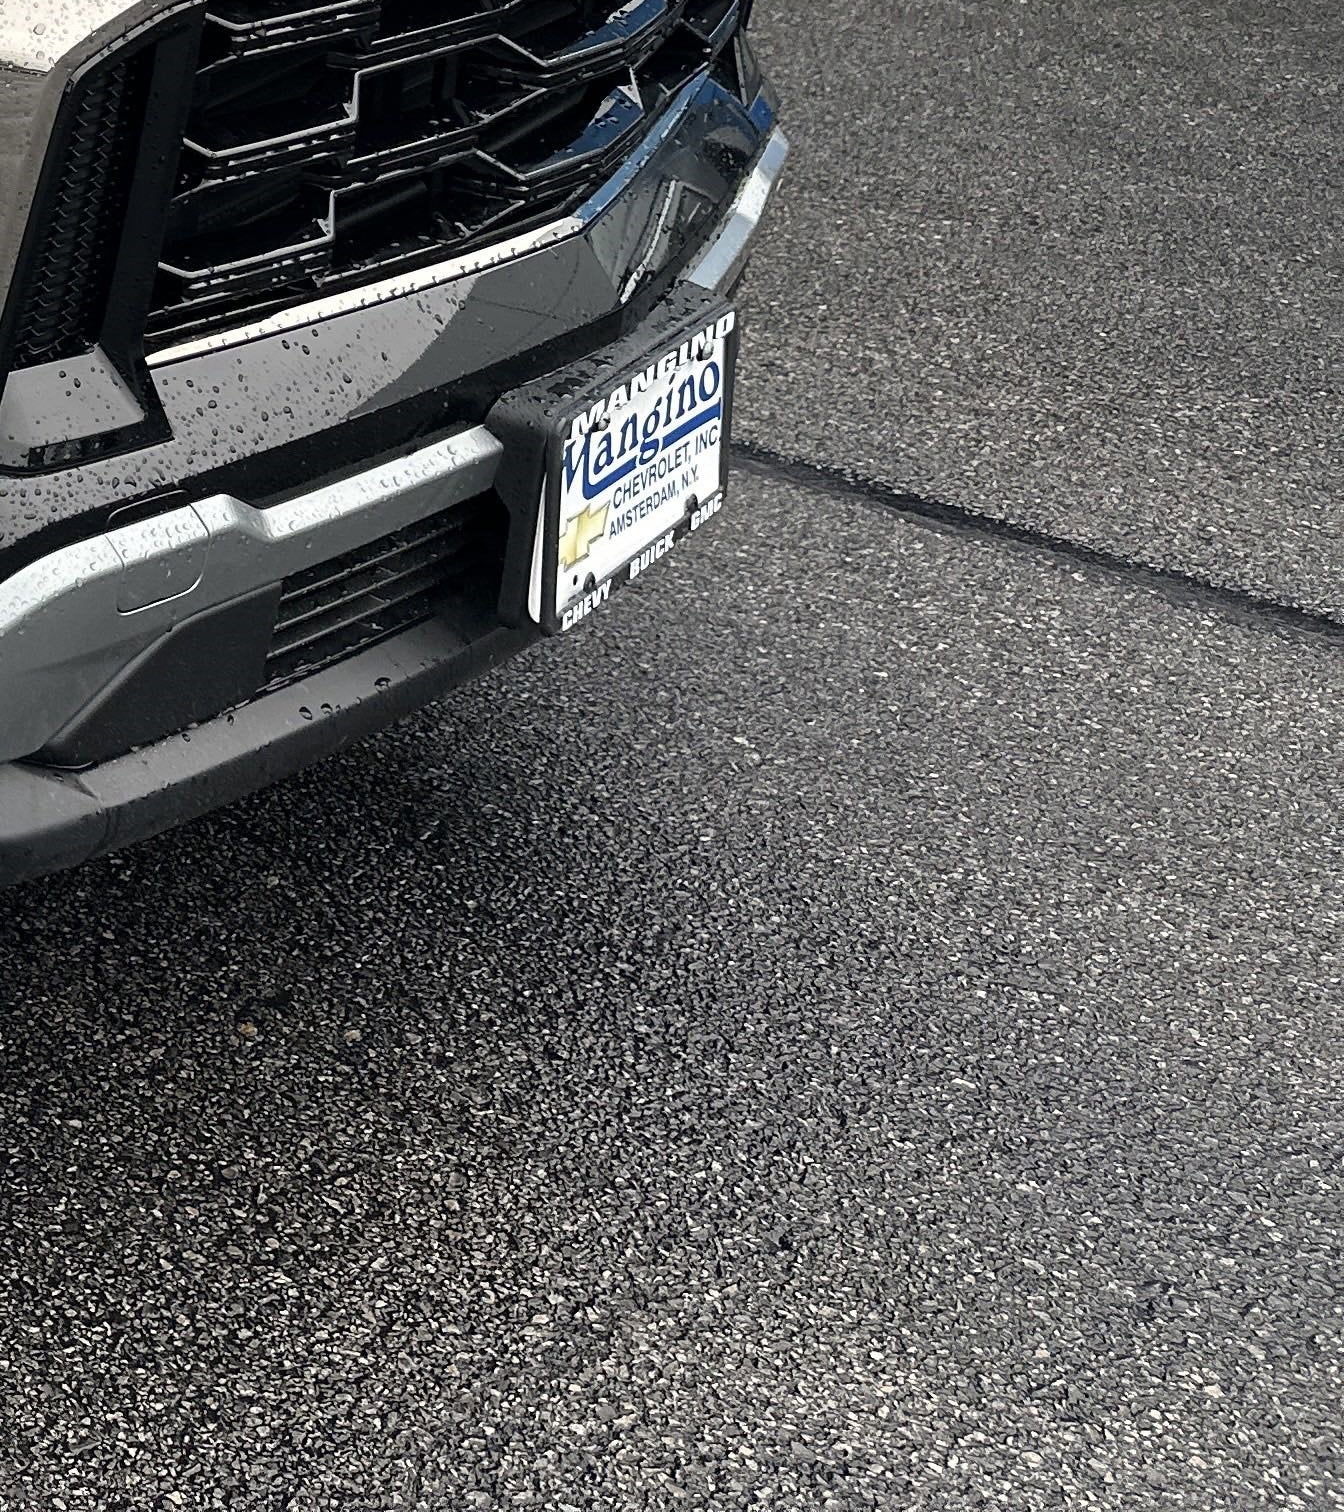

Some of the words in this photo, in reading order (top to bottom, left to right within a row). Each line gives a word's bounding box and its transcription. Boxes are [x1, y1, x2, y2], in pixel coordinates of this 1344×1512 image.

[561, 361, 721, 499] Mangino
[570, 311, 735, 440] MANGINO
[609, 478, 680, 538] AMSTERDAM,
[613, 439, 691, 508] CHEVROLET,
[562, 579, 612, 632] CHEVY
[629, 530, 675, 579] BUICK
[690, 492, 723, 530] GMC
